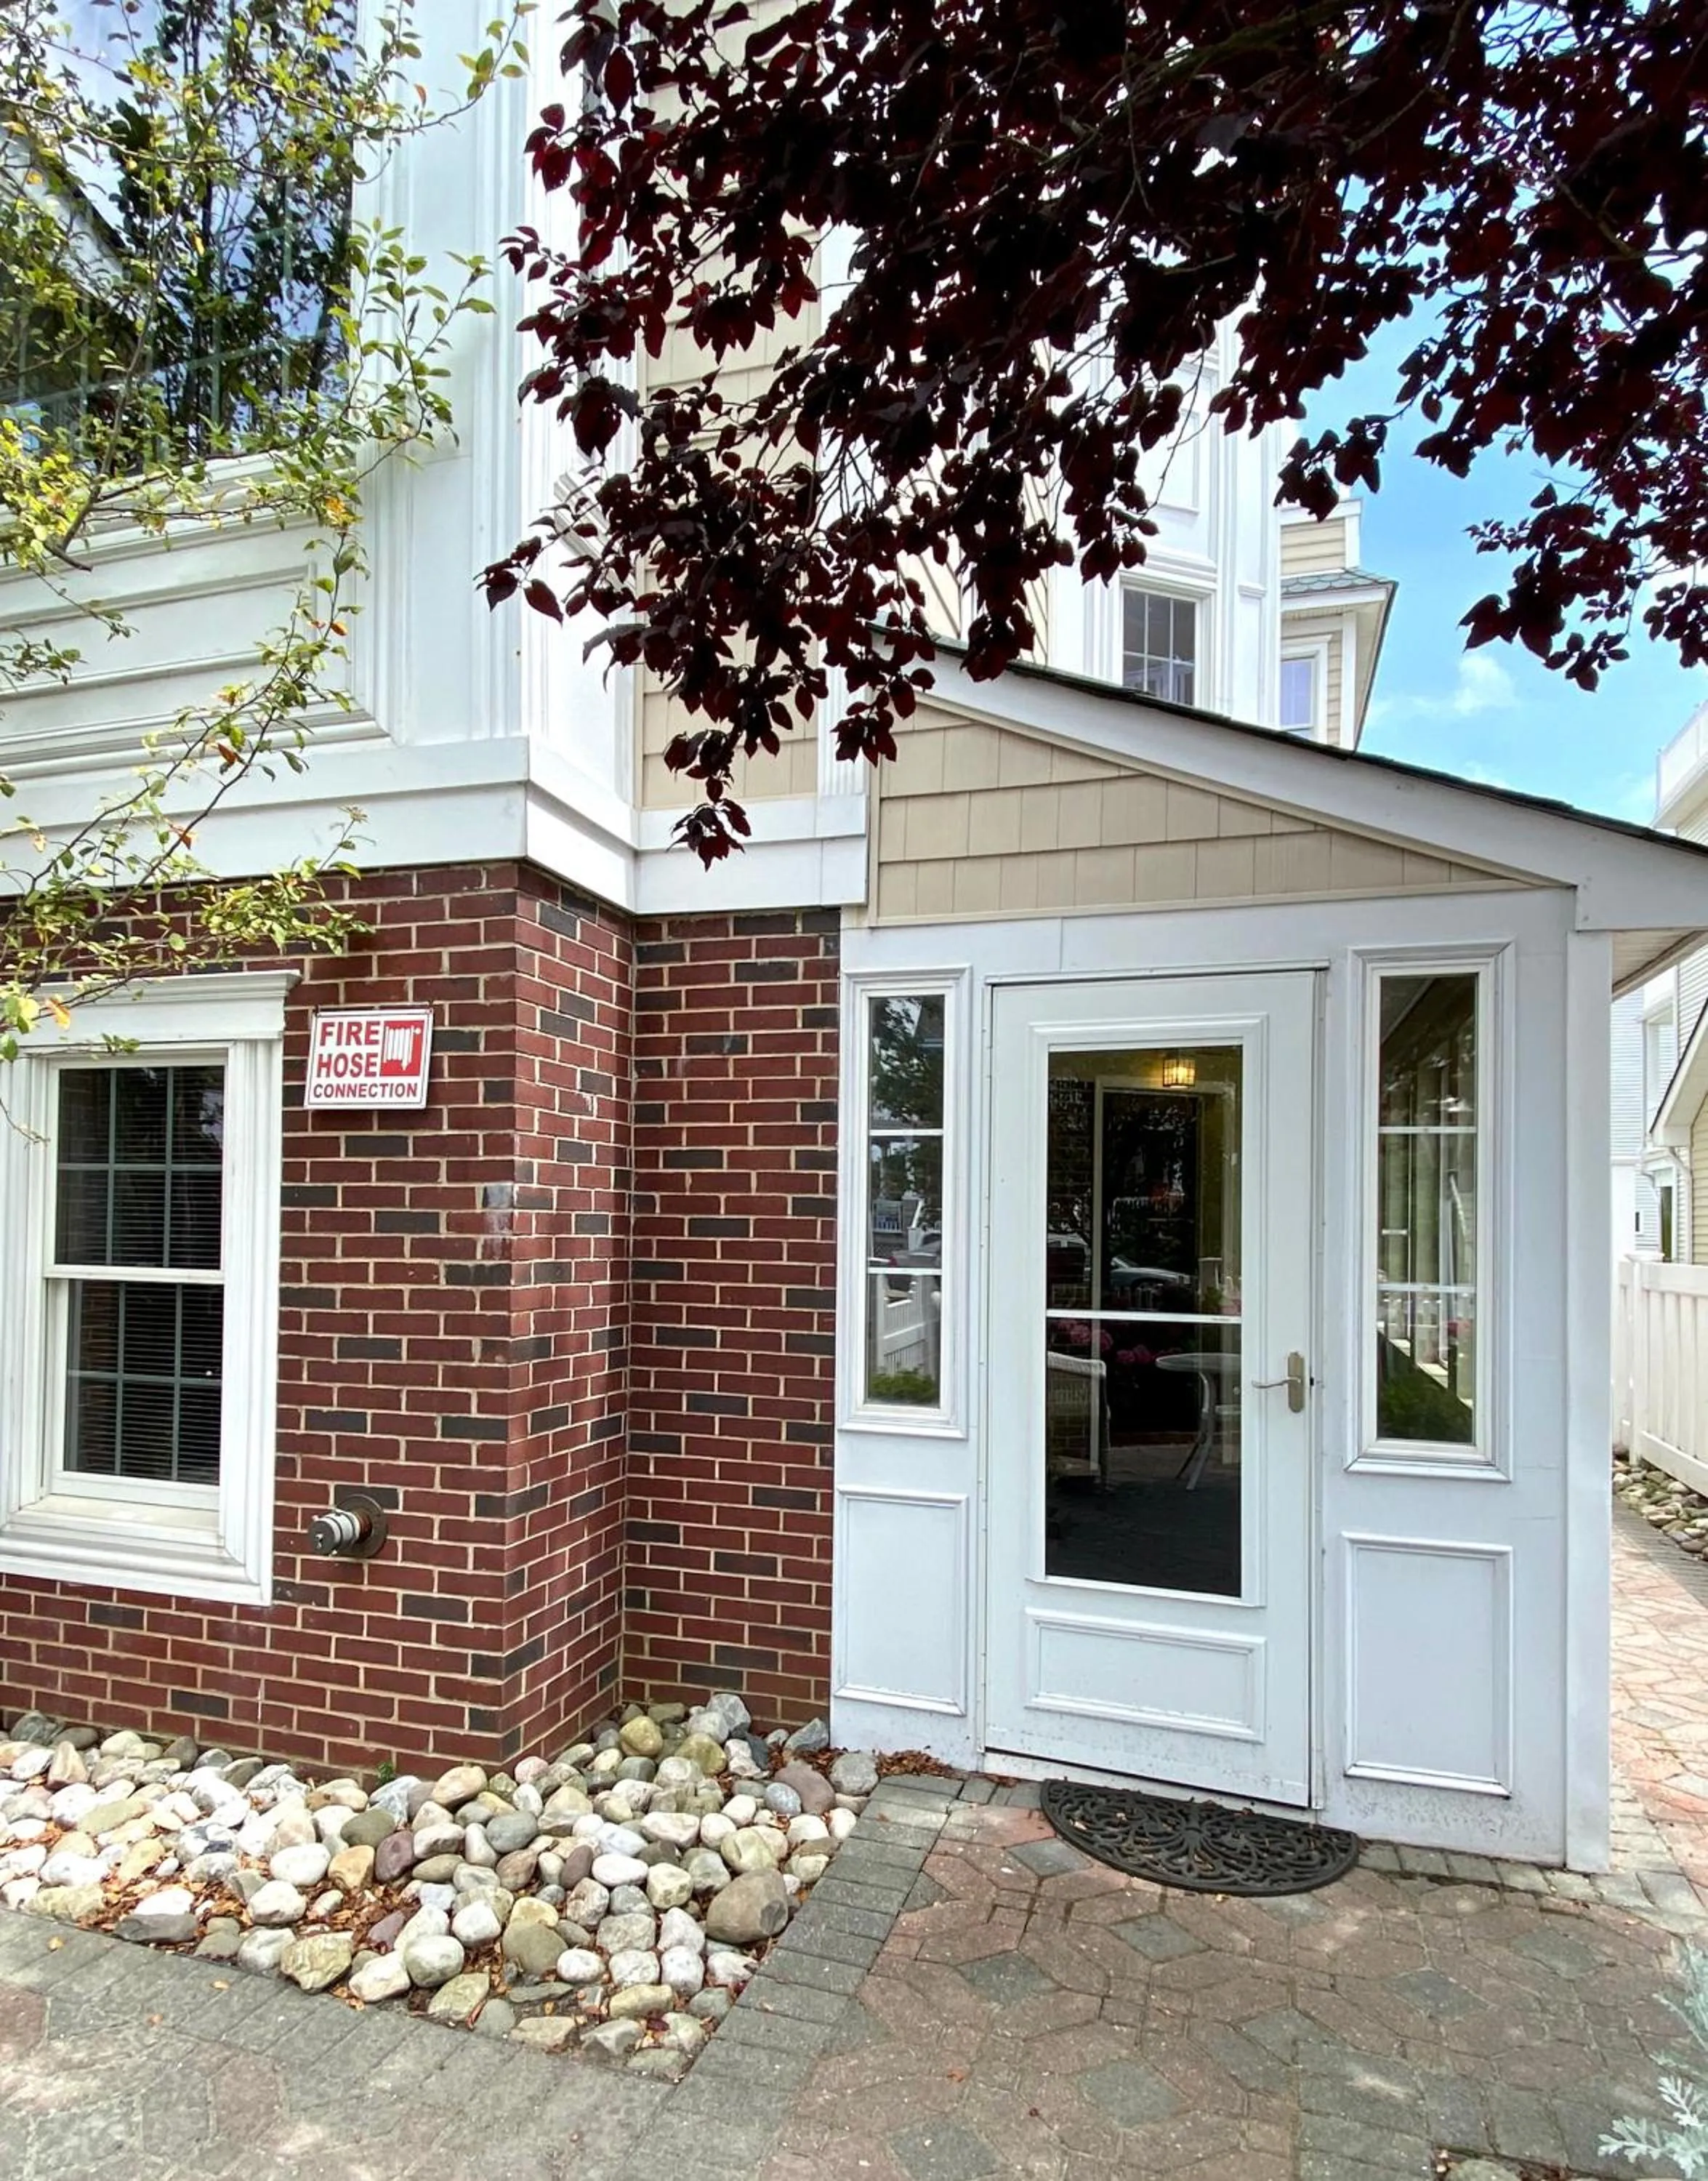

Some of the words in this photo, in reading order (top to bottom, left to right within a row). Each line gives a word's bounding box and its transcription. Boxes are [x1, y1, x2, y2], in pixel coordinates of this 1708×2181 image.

[320, 1021, 380, 1046] FIRE
[316, 1053, 378, 1078] HOSE
[313, 1083, 418, 1098] CONNECTION
